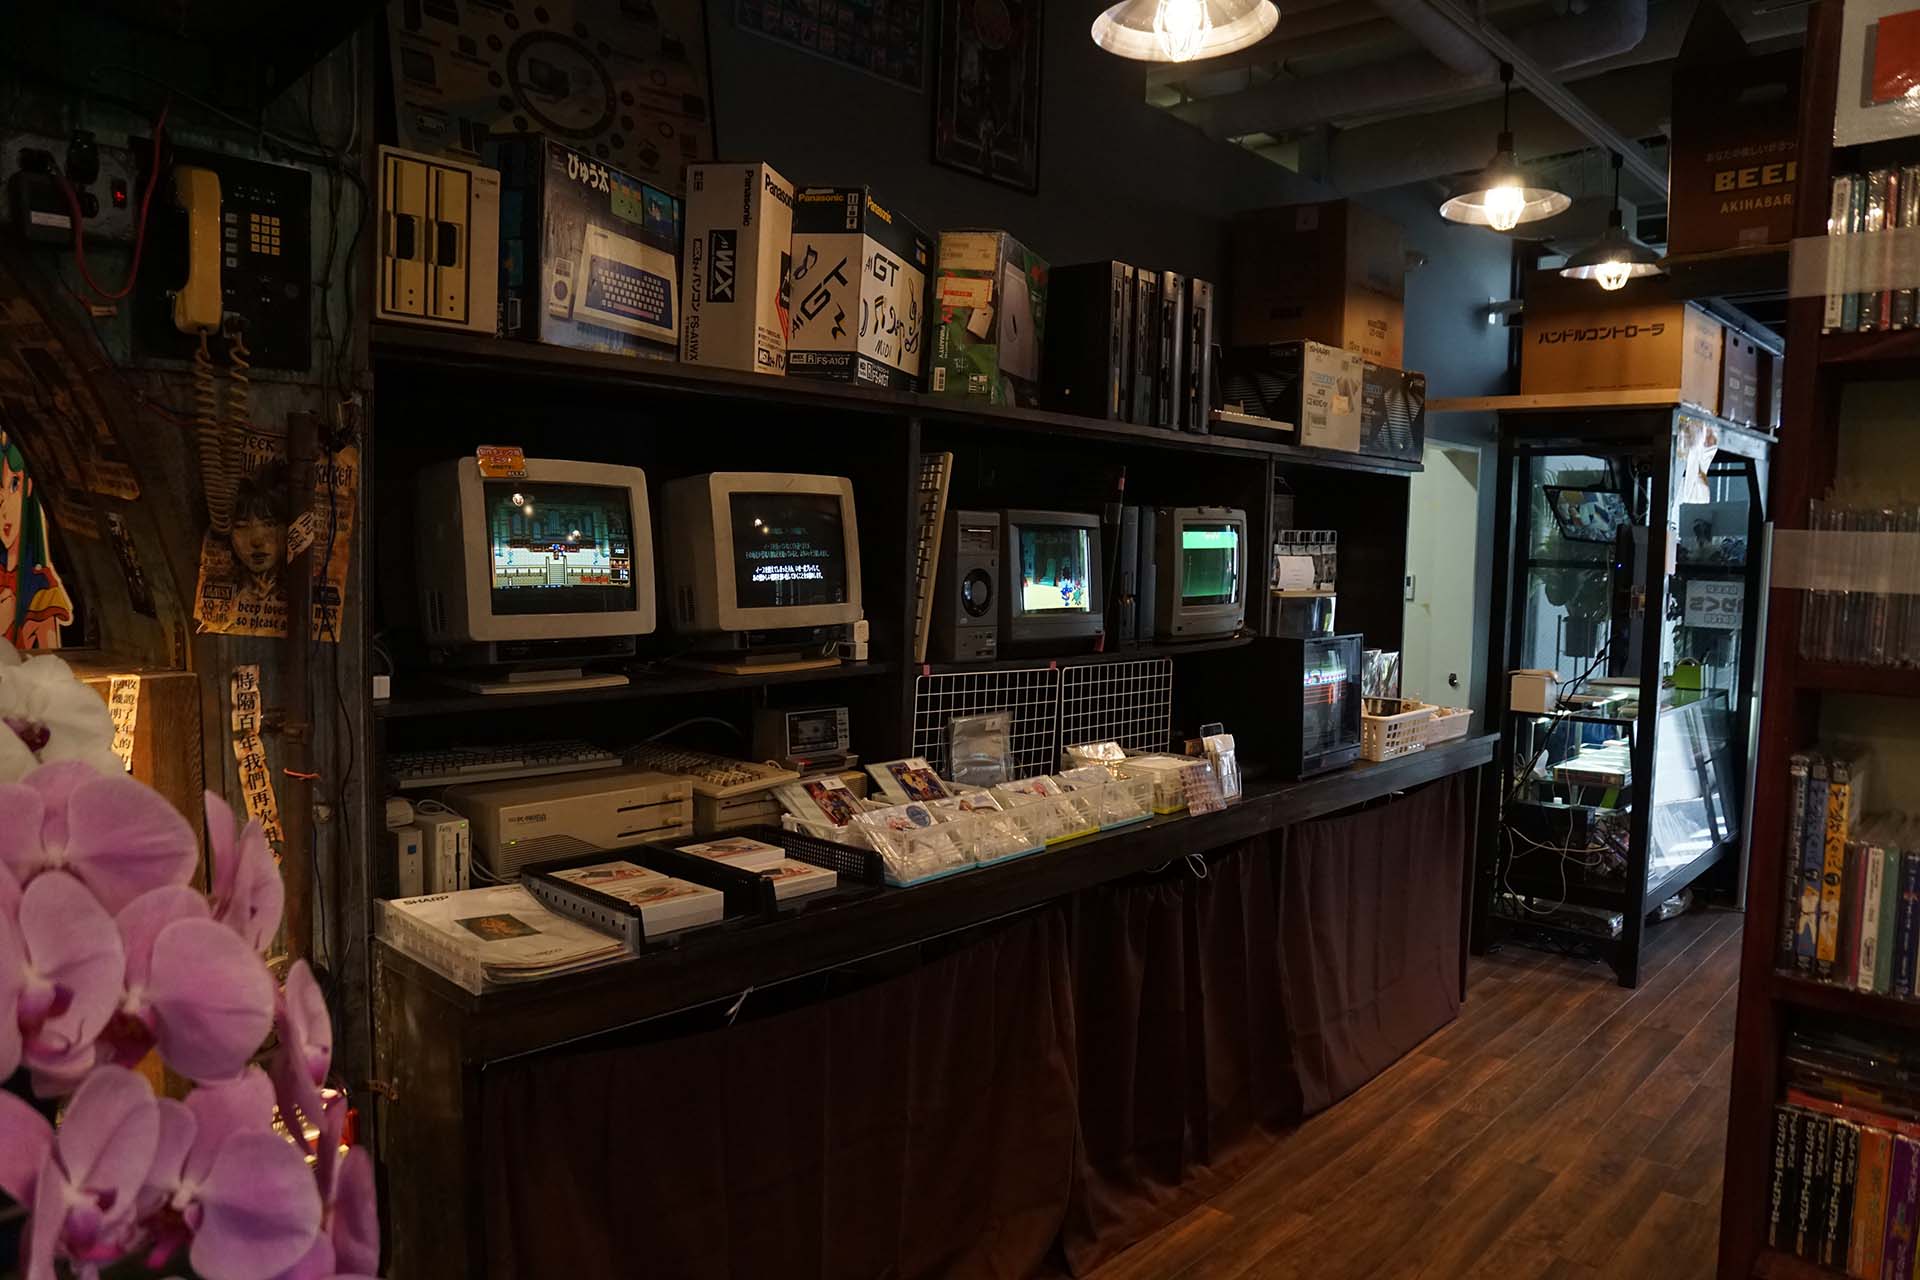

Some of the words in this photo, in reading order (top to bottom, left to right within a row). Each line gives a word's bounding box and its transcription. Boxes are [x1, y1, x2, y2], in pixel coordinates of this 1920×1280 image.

[568, 152, 610, 194] ぴゅう太
[743, 169, 754, 227] Panasonic
[798, 193, 846, 204] Panasonic
[691, 273, 702, 312] パソコン
[689, 315, 700, 361] FS-A1WX
[1538, 323, 1666, 344] ハンドルコントローラ
[816, 357, 850, 366] FS-A1GT
[238, 601, 261, 615] beep
[236, 616, 247, 626] so
[250, 616, 278, 629] please
[402, 895, 449, 906] SHARP
